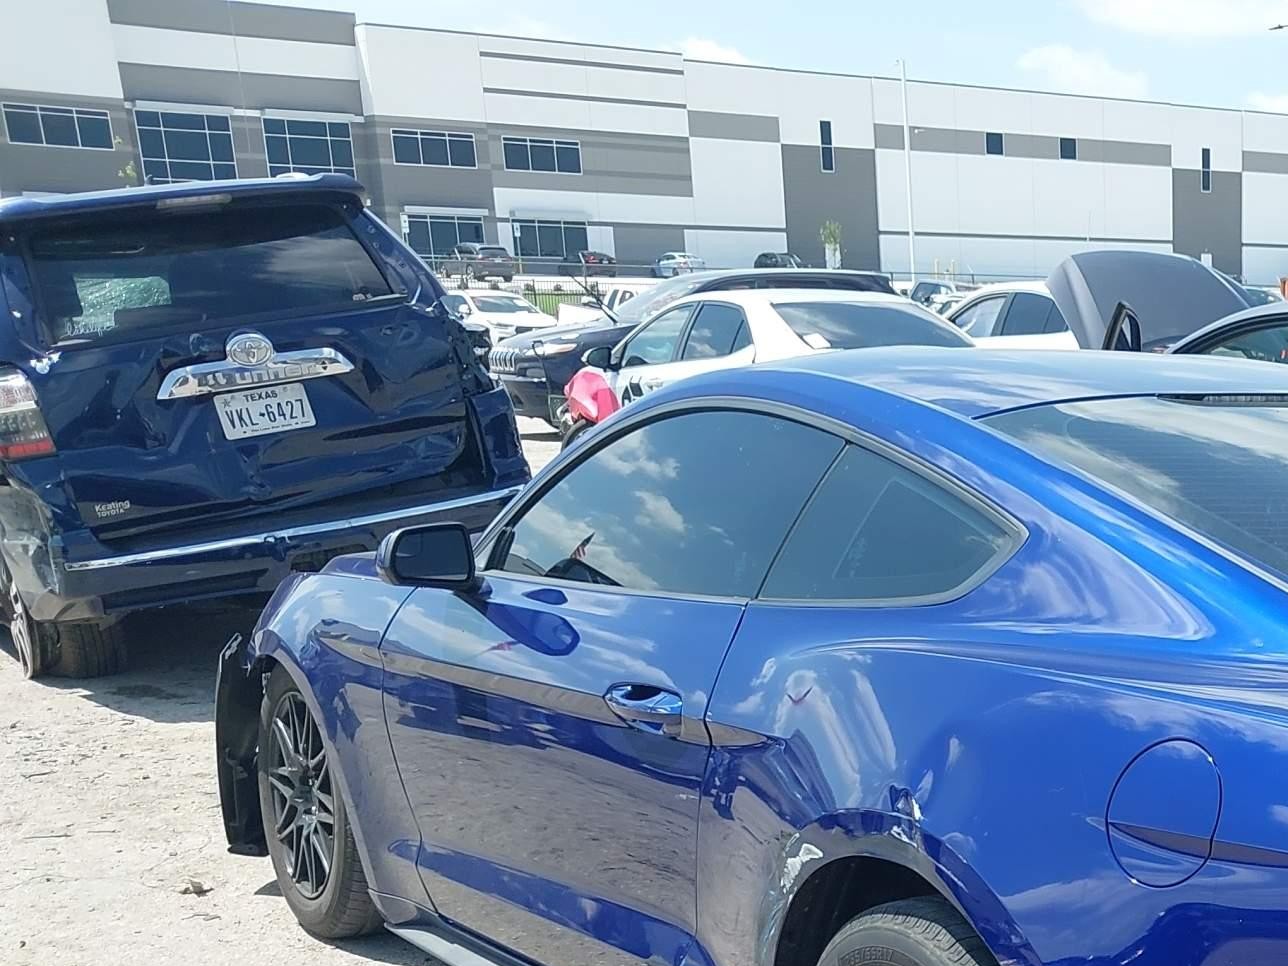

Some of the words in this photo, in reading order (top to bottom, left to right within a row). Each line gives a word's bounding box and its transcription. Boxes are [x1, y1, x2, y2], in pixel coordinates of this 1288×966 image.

[242, 389, 279, 403] TEXAS
[225, 407, 259, 430] VKL
[264, 398, 307, 424] 6427
[94, 500, 131, 513] Keating
[97, 509, 125, 519] TOYOTA
